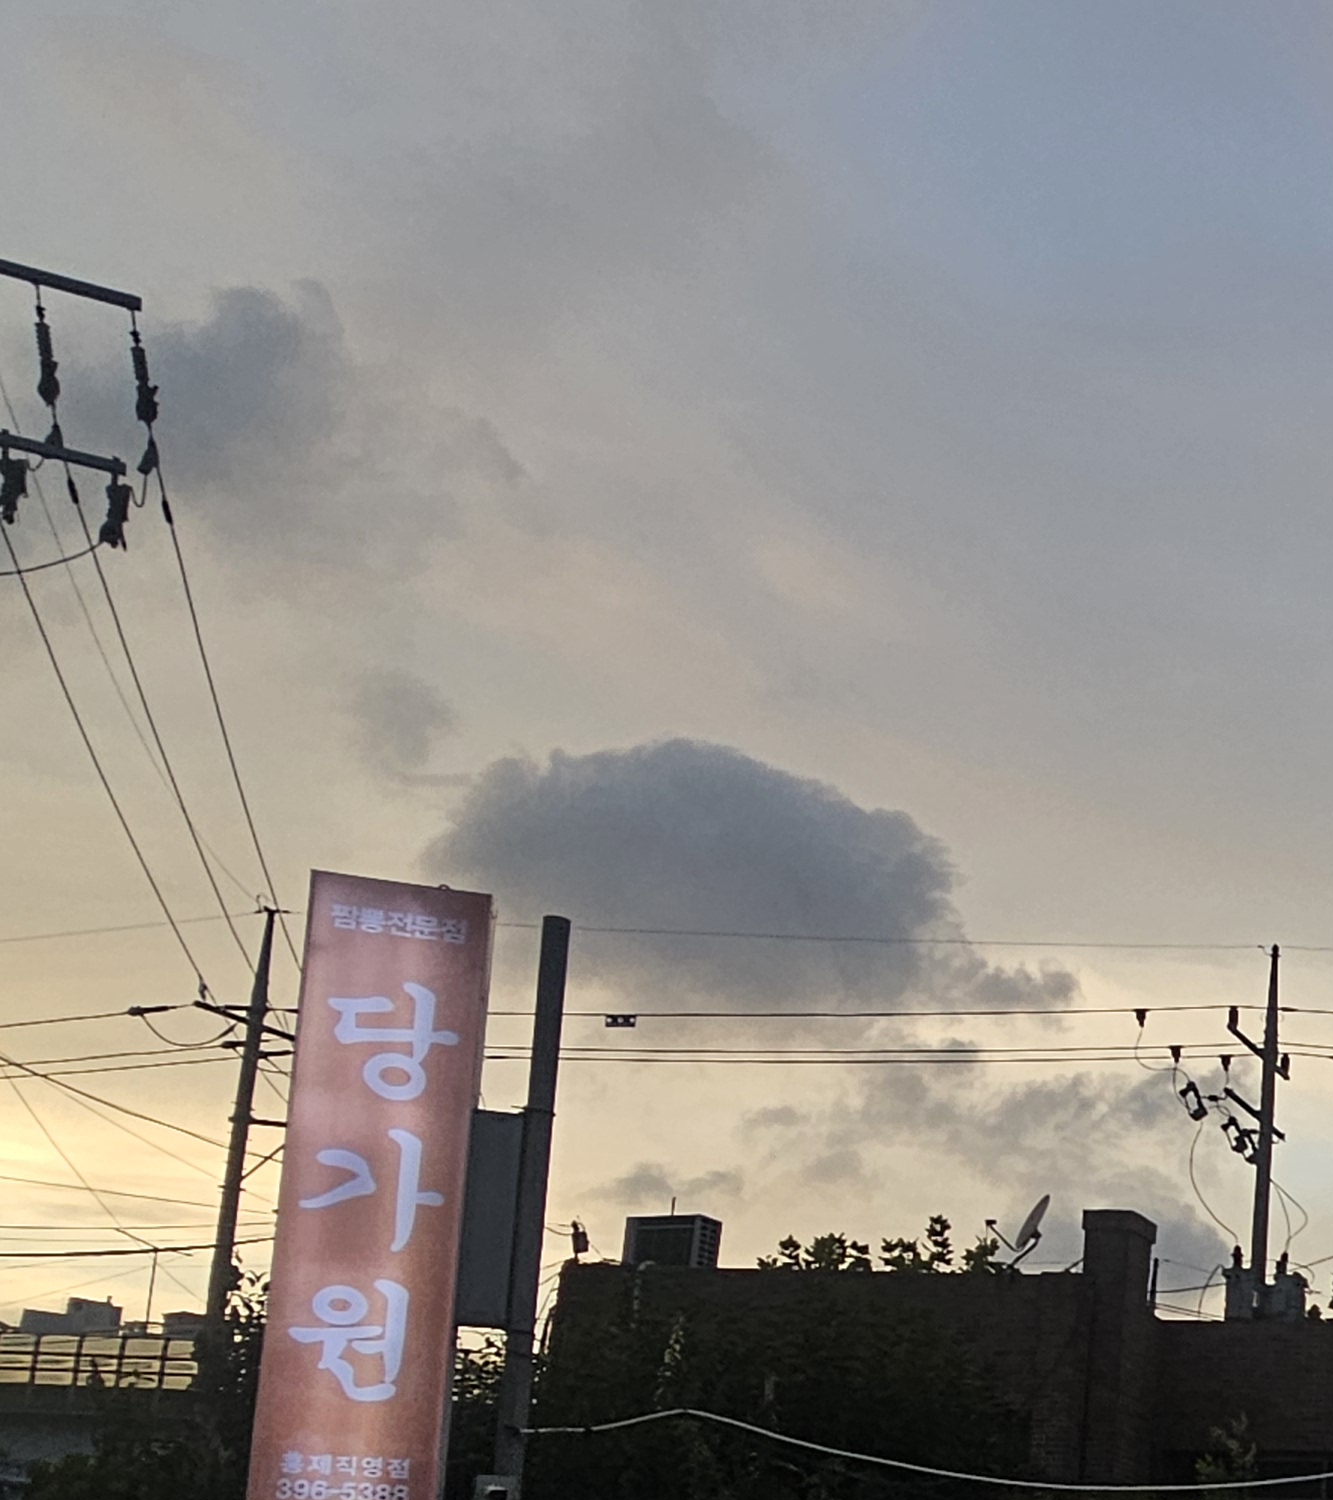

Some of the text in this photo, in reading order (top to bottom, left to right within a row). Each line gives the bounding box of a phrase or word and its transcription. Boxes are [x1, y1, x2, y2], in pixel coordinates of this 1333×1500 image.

[331, 903, 469, 945] 짬뽕전문점
[288, 981, 461, 1402] 당가원
[280, 1450, 410, 1480] 홍제직영점
